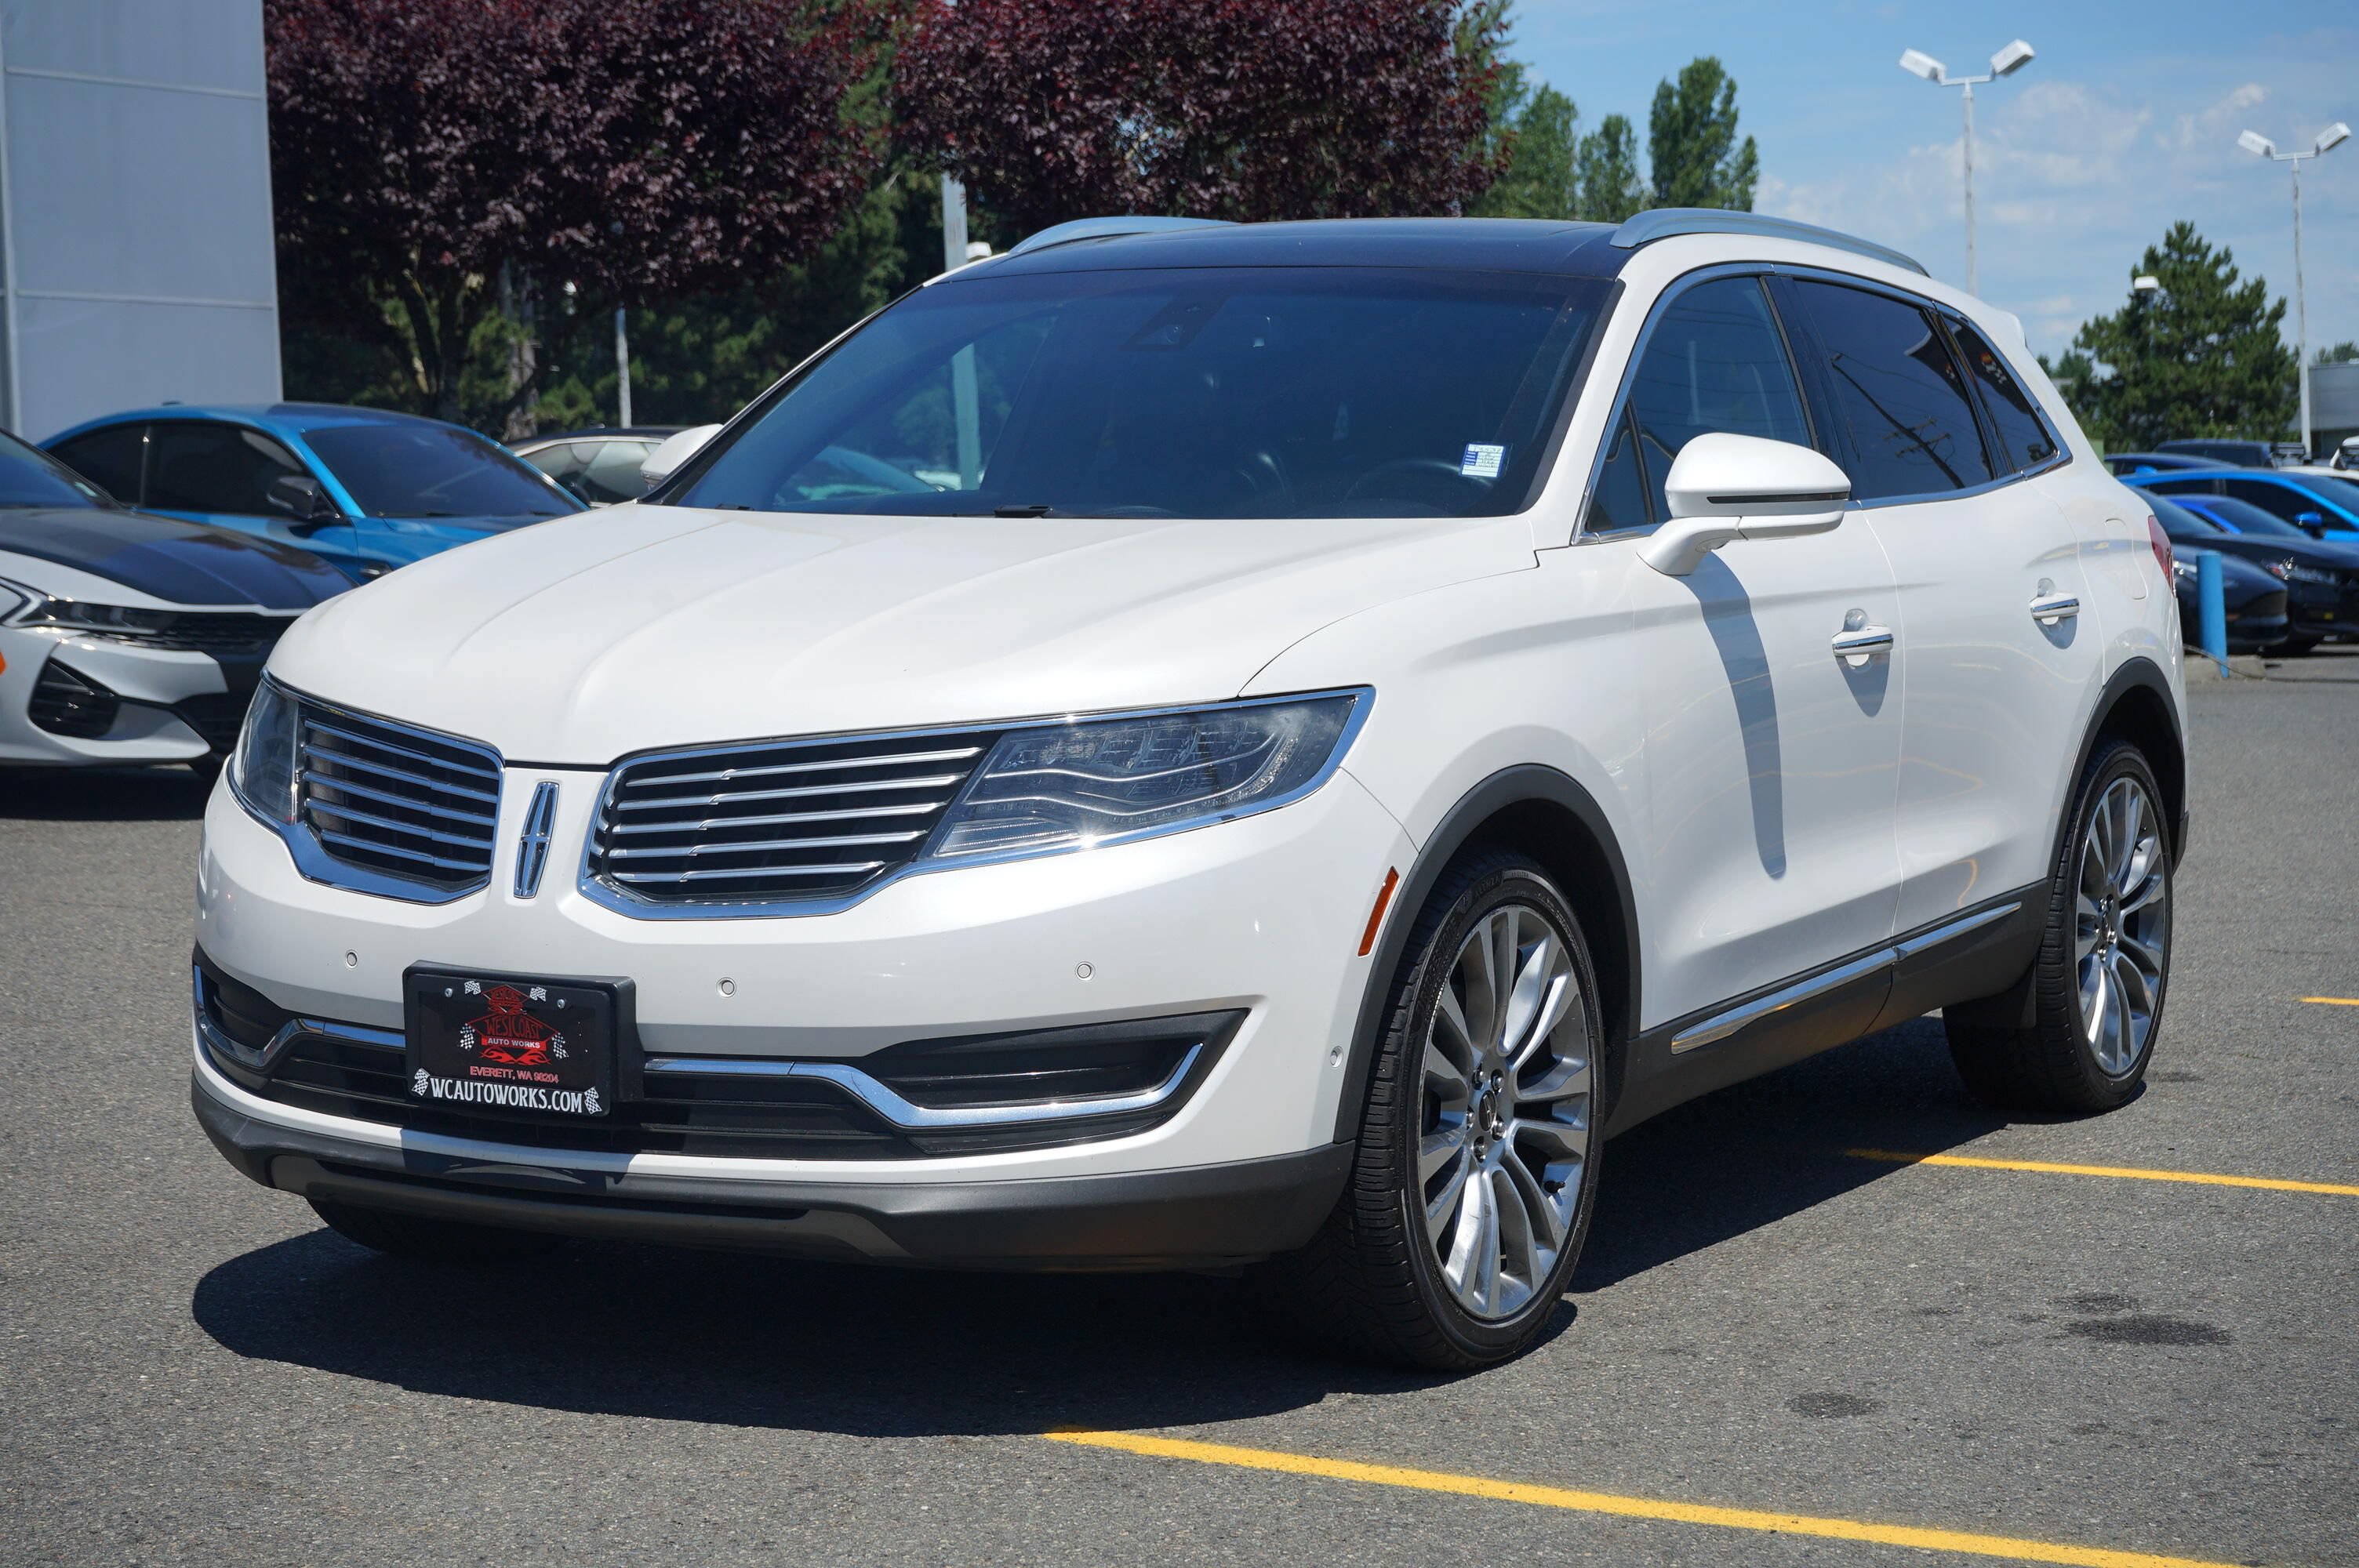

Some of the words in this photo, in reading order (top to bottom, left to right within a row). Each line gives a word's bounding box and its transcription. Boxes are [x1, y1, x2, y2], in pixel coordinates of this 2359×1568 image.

[470, 1065, 516, 1080] EVERETT,
[517, 1070, 533, 1080] WA
[533, 1072, 558, 1083] 98204
[431, 1077, 582, 1113] WCAUTOWORKS.COM
